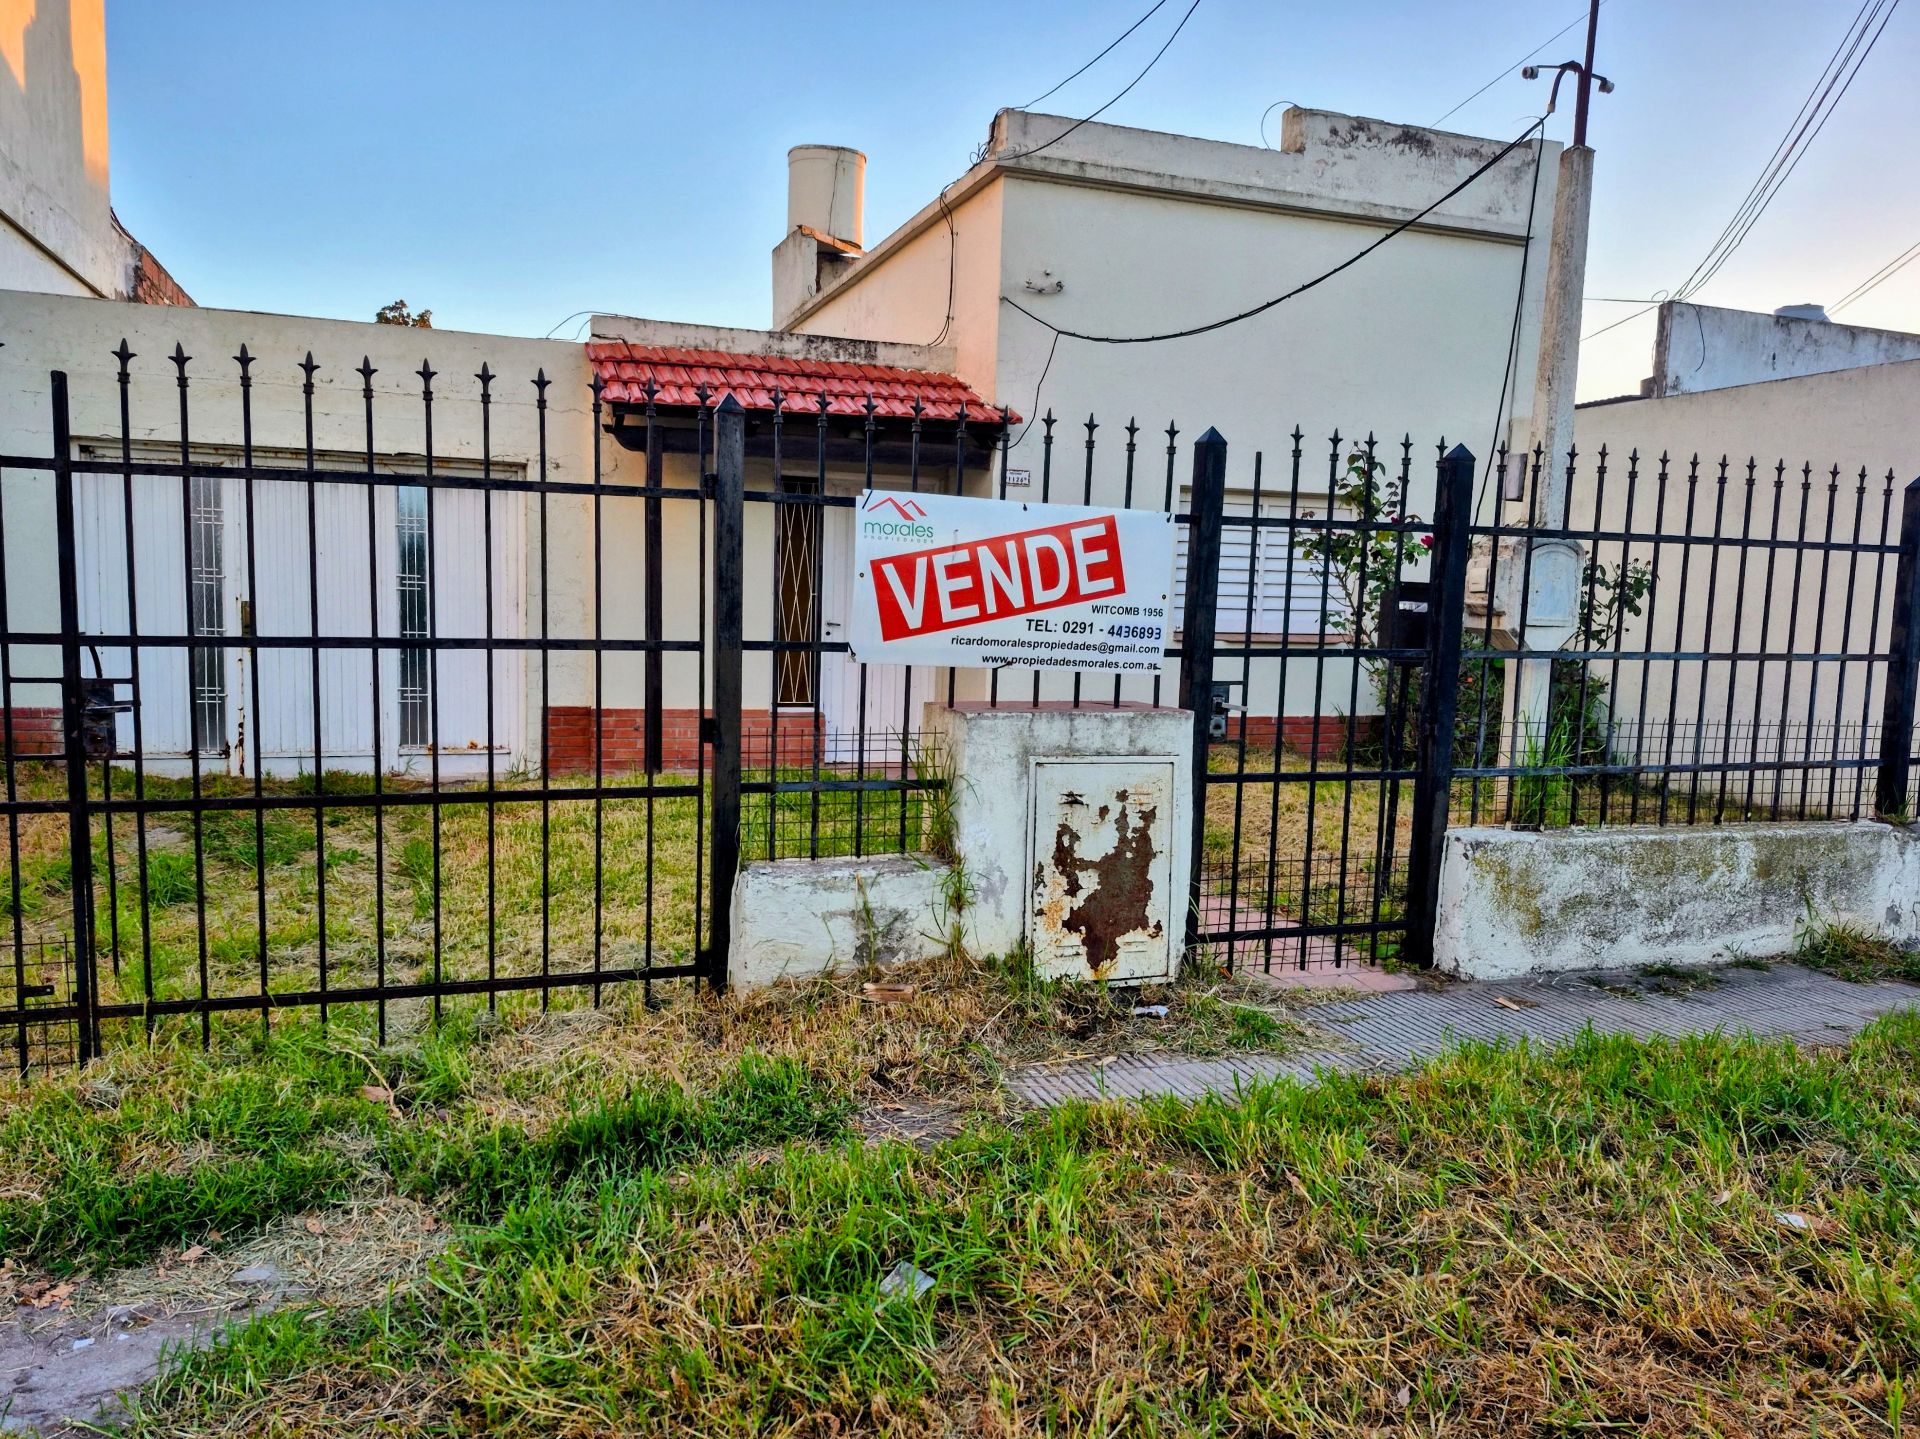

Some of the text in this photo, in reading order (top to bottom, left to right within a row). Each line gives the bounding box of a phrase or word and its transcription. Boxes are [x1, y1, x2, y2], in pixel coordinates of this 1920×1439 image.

[864, 522, 934, 538] morales
[881, 522, 1115, 630] VENDE
[1091, 605, 1164, 617] WITCOMB 1956
[1025, 619, 1058, 633] TEL:
[1062, 621, 1094, 634] 0291
[1107, 625, 1162, 640] 4436893
[951, 636, 1160, 654] ricardomoralespropiedades@gmail.com
